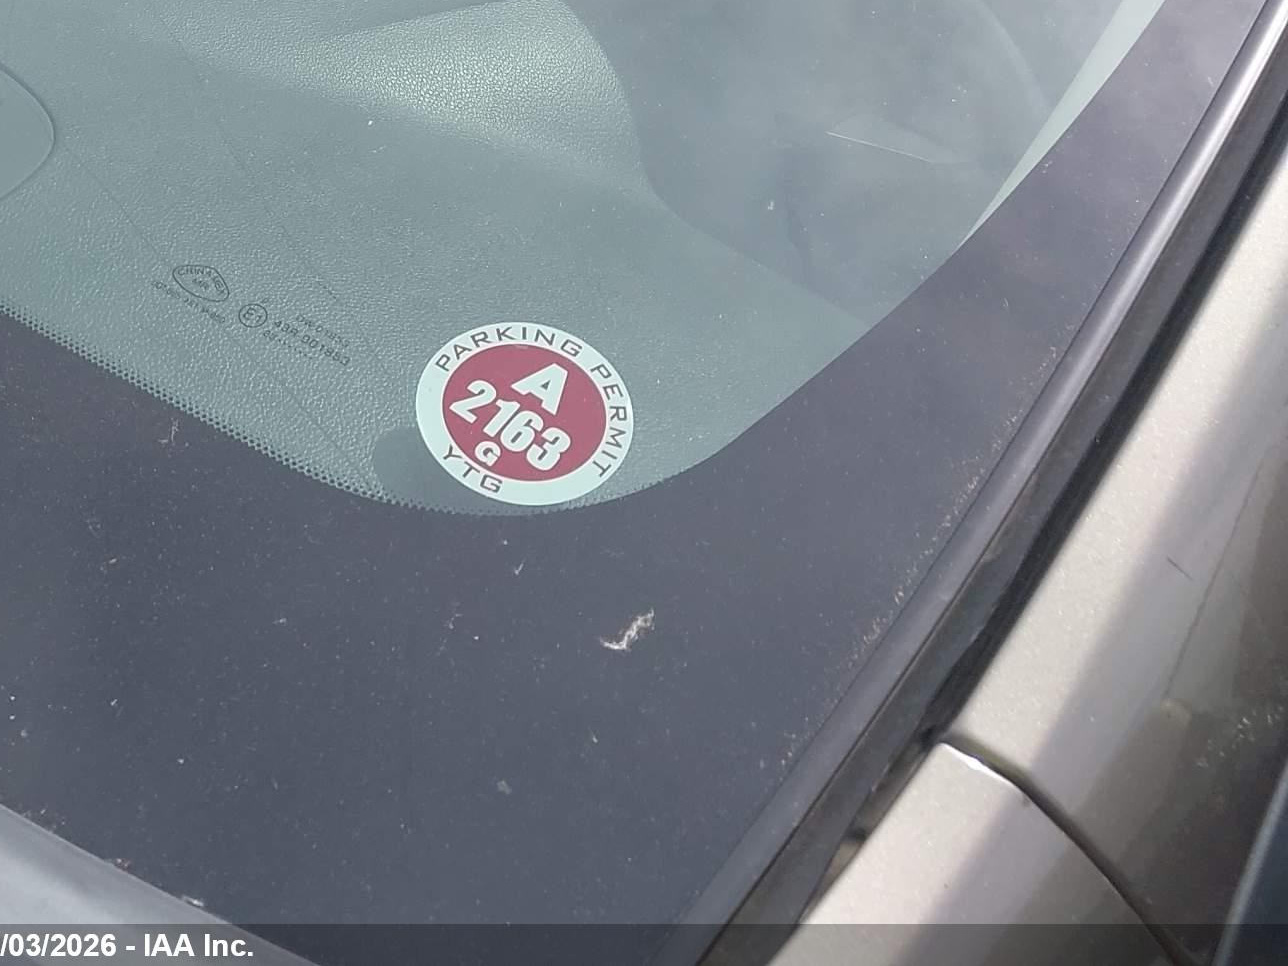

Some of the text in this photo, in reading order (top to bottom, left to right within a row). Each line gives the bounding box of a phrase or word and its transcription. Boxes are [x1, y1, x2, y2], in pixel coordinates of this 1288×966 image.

[435, 326, 628, 479] PARKING PERMIT
[511, 362, 569, 416] A
[449, 379, 572, 472] 2163
[443, 443, 504, 494] YTG
[474, 440, 503, 467] G
